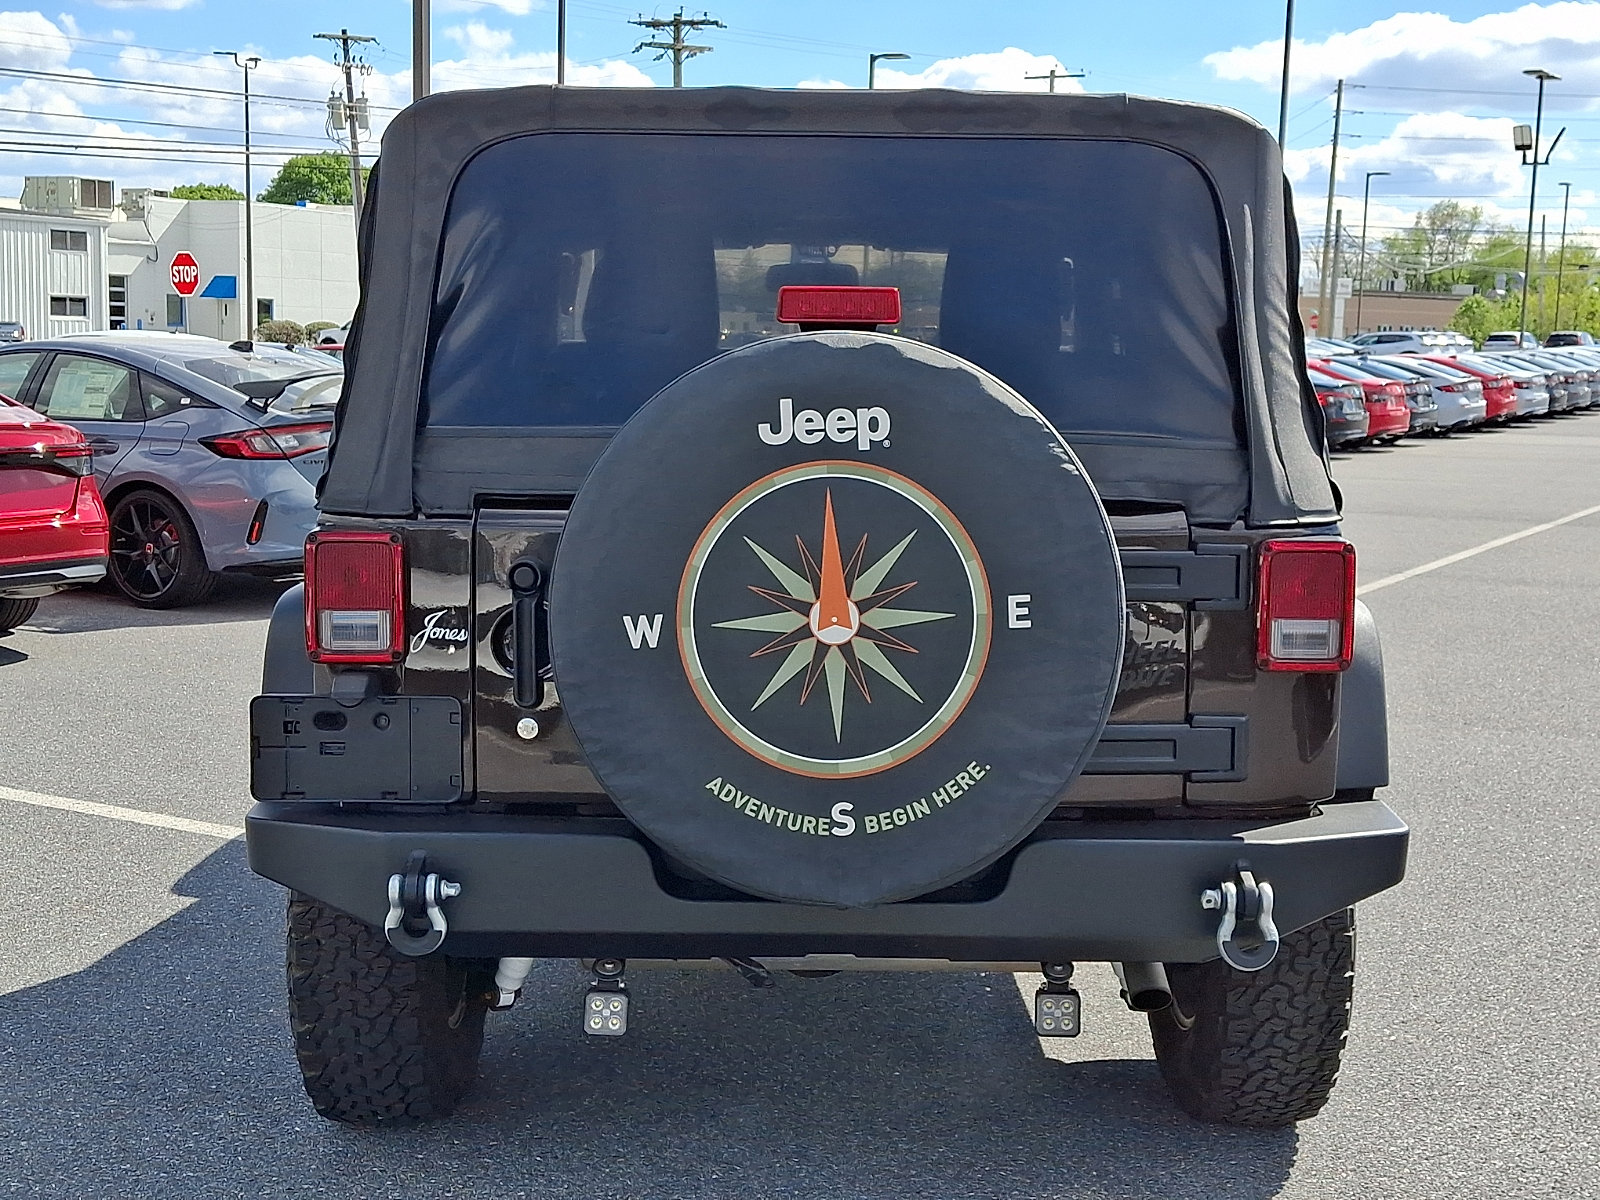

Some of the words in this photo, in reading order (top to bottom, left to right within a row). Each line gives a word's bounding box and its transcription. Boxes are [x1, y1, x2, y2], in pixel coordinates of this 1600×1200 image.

[172, 265, 197, 283] STOP
[757, 398, 891, 450] Jeep
[410, 609, 469, 653] Jones
[622, 613, 664, 649] W
[1007, 594, 1032, 629] E
[864, 798, 931, 834] BEGIN
[931, 760, 992, 808] HERE.
